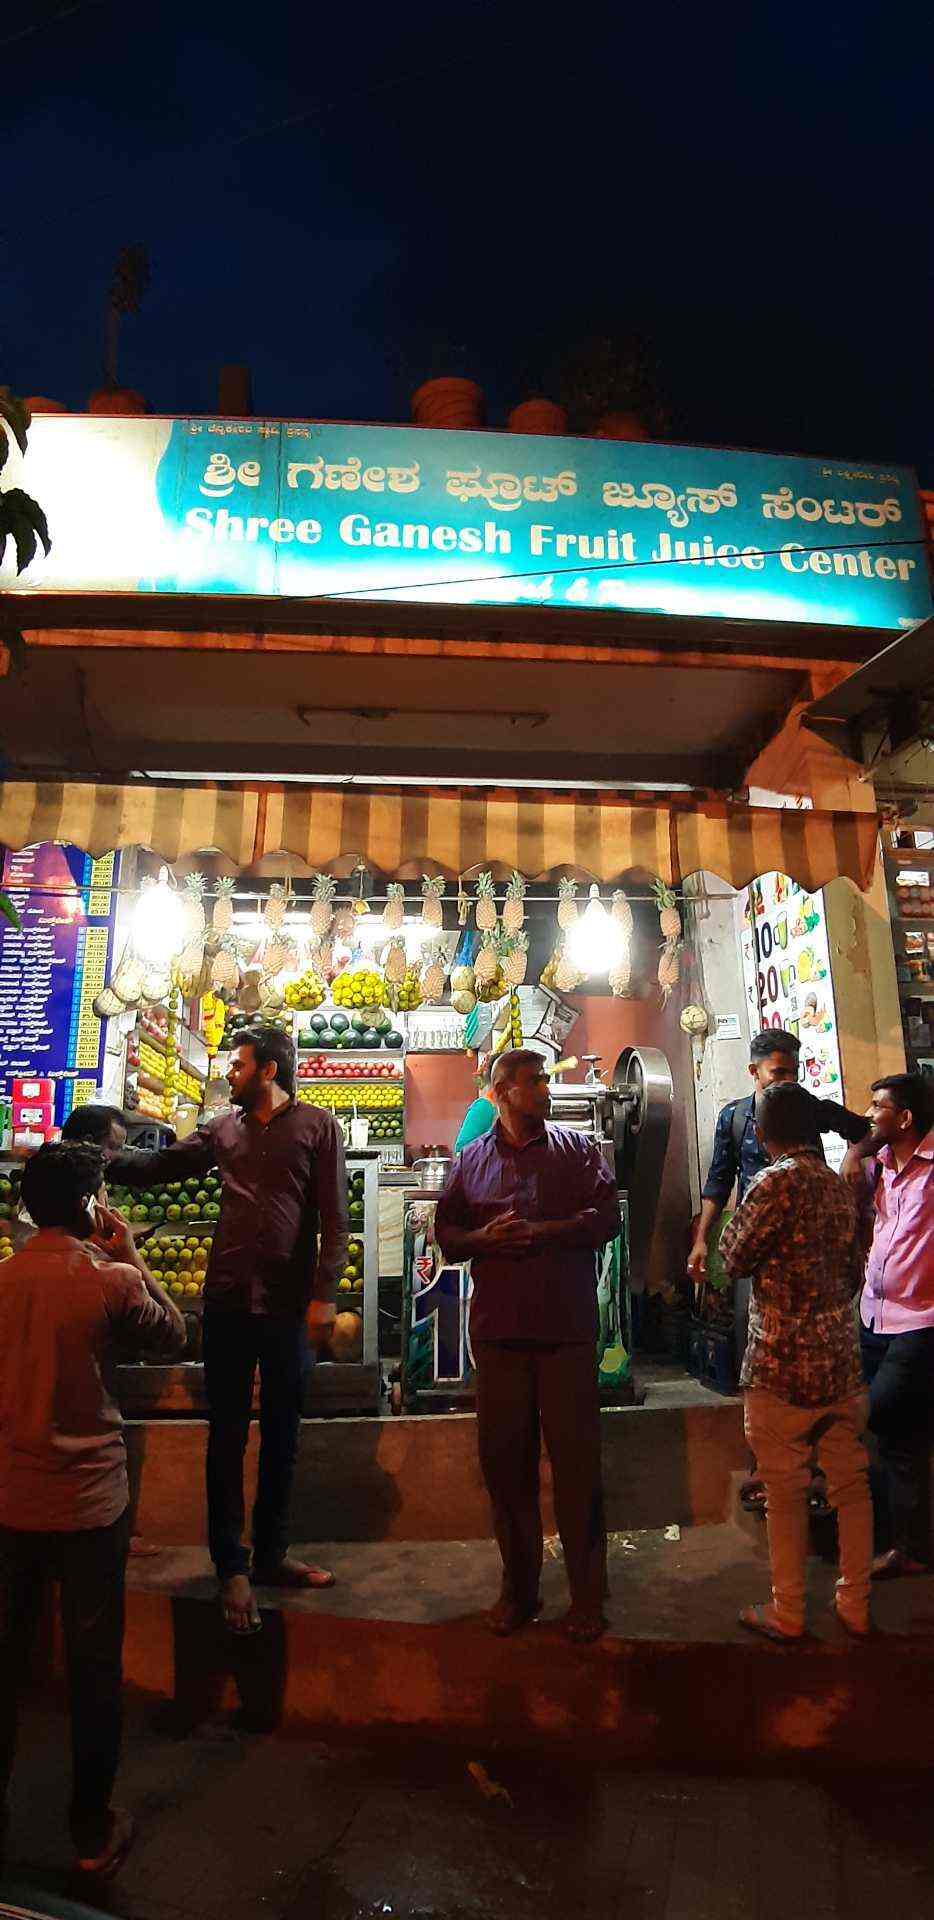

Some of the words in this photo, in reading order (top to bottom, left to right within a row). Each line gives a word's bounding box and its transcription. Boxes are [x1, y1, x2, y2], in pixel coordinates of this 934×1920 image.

[199, 452, 261, 498] ಶ್ರೀ
[287, 456, 420, 493] ಗಣೇಶ
[602, 481, 737, 528] ಜ್ಯೂಸ್
[761, 487, 902, 527] ಸೆಂಟರ್
[185, 508, 321, 544] Shree
[340, 514, 511, 554] Ganesh
[529, 524, 637, 562] Fruit
[651, 532, 765, 570] Juice
[780, 542, 916, 581] Center
[411, 1264, 475, 1383] 1
